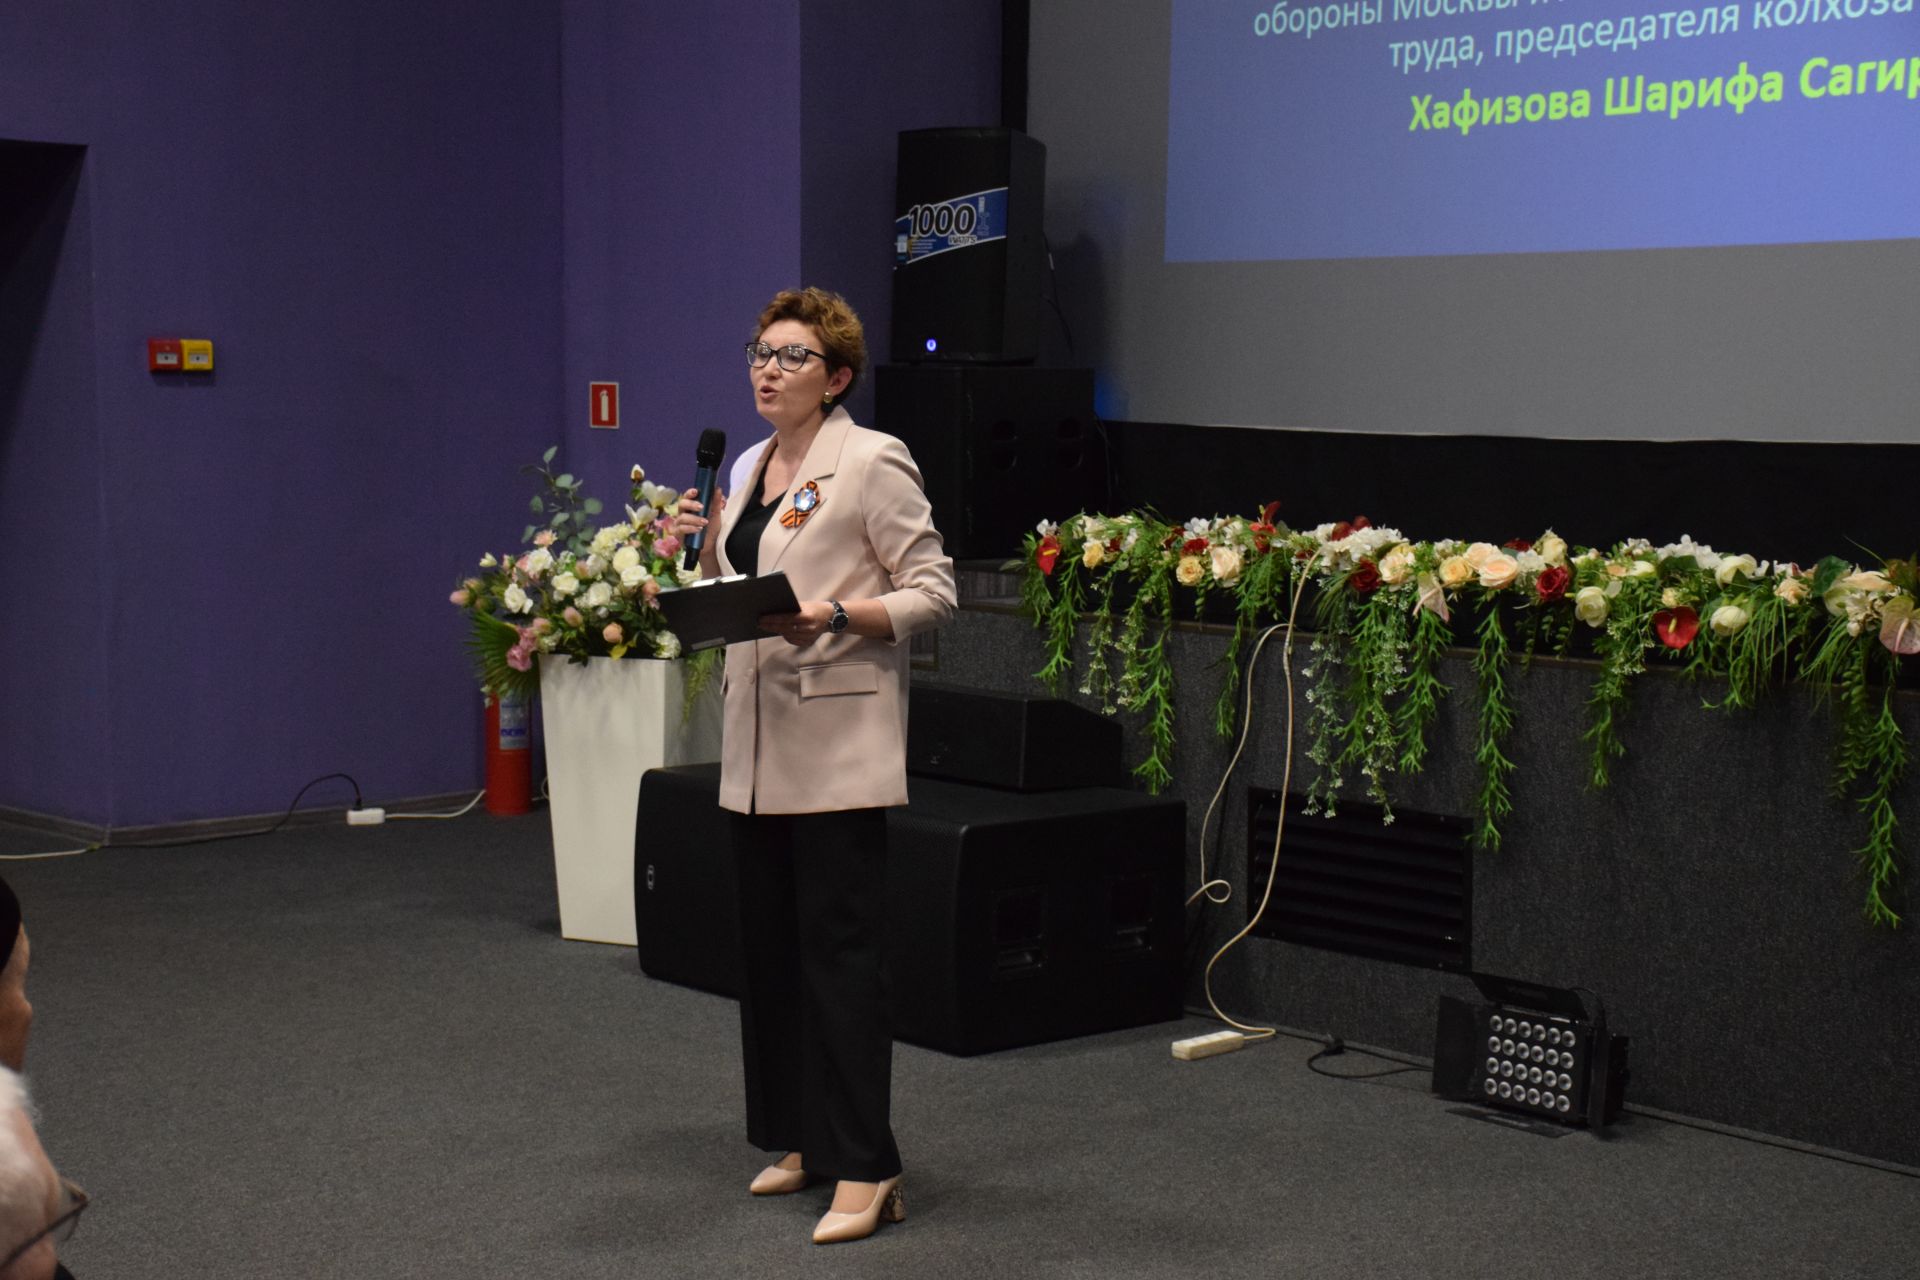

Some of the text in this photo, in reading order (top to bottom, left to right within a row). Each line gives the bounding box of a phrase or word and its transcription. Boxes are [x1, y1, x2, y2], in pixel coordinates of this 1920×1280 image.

[1254, 1, 1382, 39] обороны
[1389, 35, 1483, 74] труда,
[1495, 4, 1740, 63] председателя
[1408, 88, 1590, 136] Хафизова
[1604, 61, 1783, 119] Шарифа
[908, 203, 976, 237] 1000
